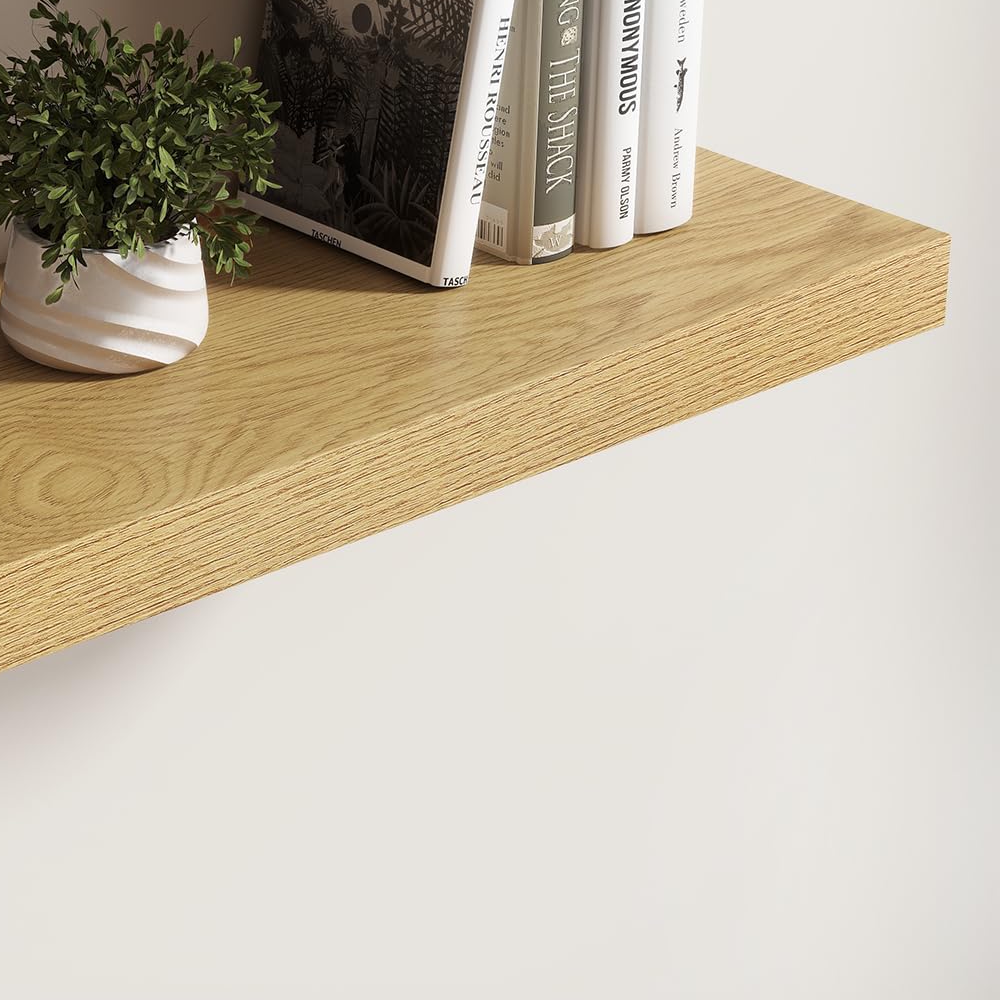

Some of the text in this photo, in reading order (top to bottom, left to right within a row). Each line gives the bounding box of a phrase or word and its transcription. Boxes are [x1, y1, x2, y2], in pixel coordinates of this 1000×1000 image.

[490, 17, 510, 84] HENRI
[470, 92, 498, 205] ROUSSEAU
[545, 48, 581, 195] THE SHACK
[619, 147, 632, 220] PARMY OLSON
[670, 128, 683, 209] Andrew Brown
[312, 229, 342, 247] TASCHEN
